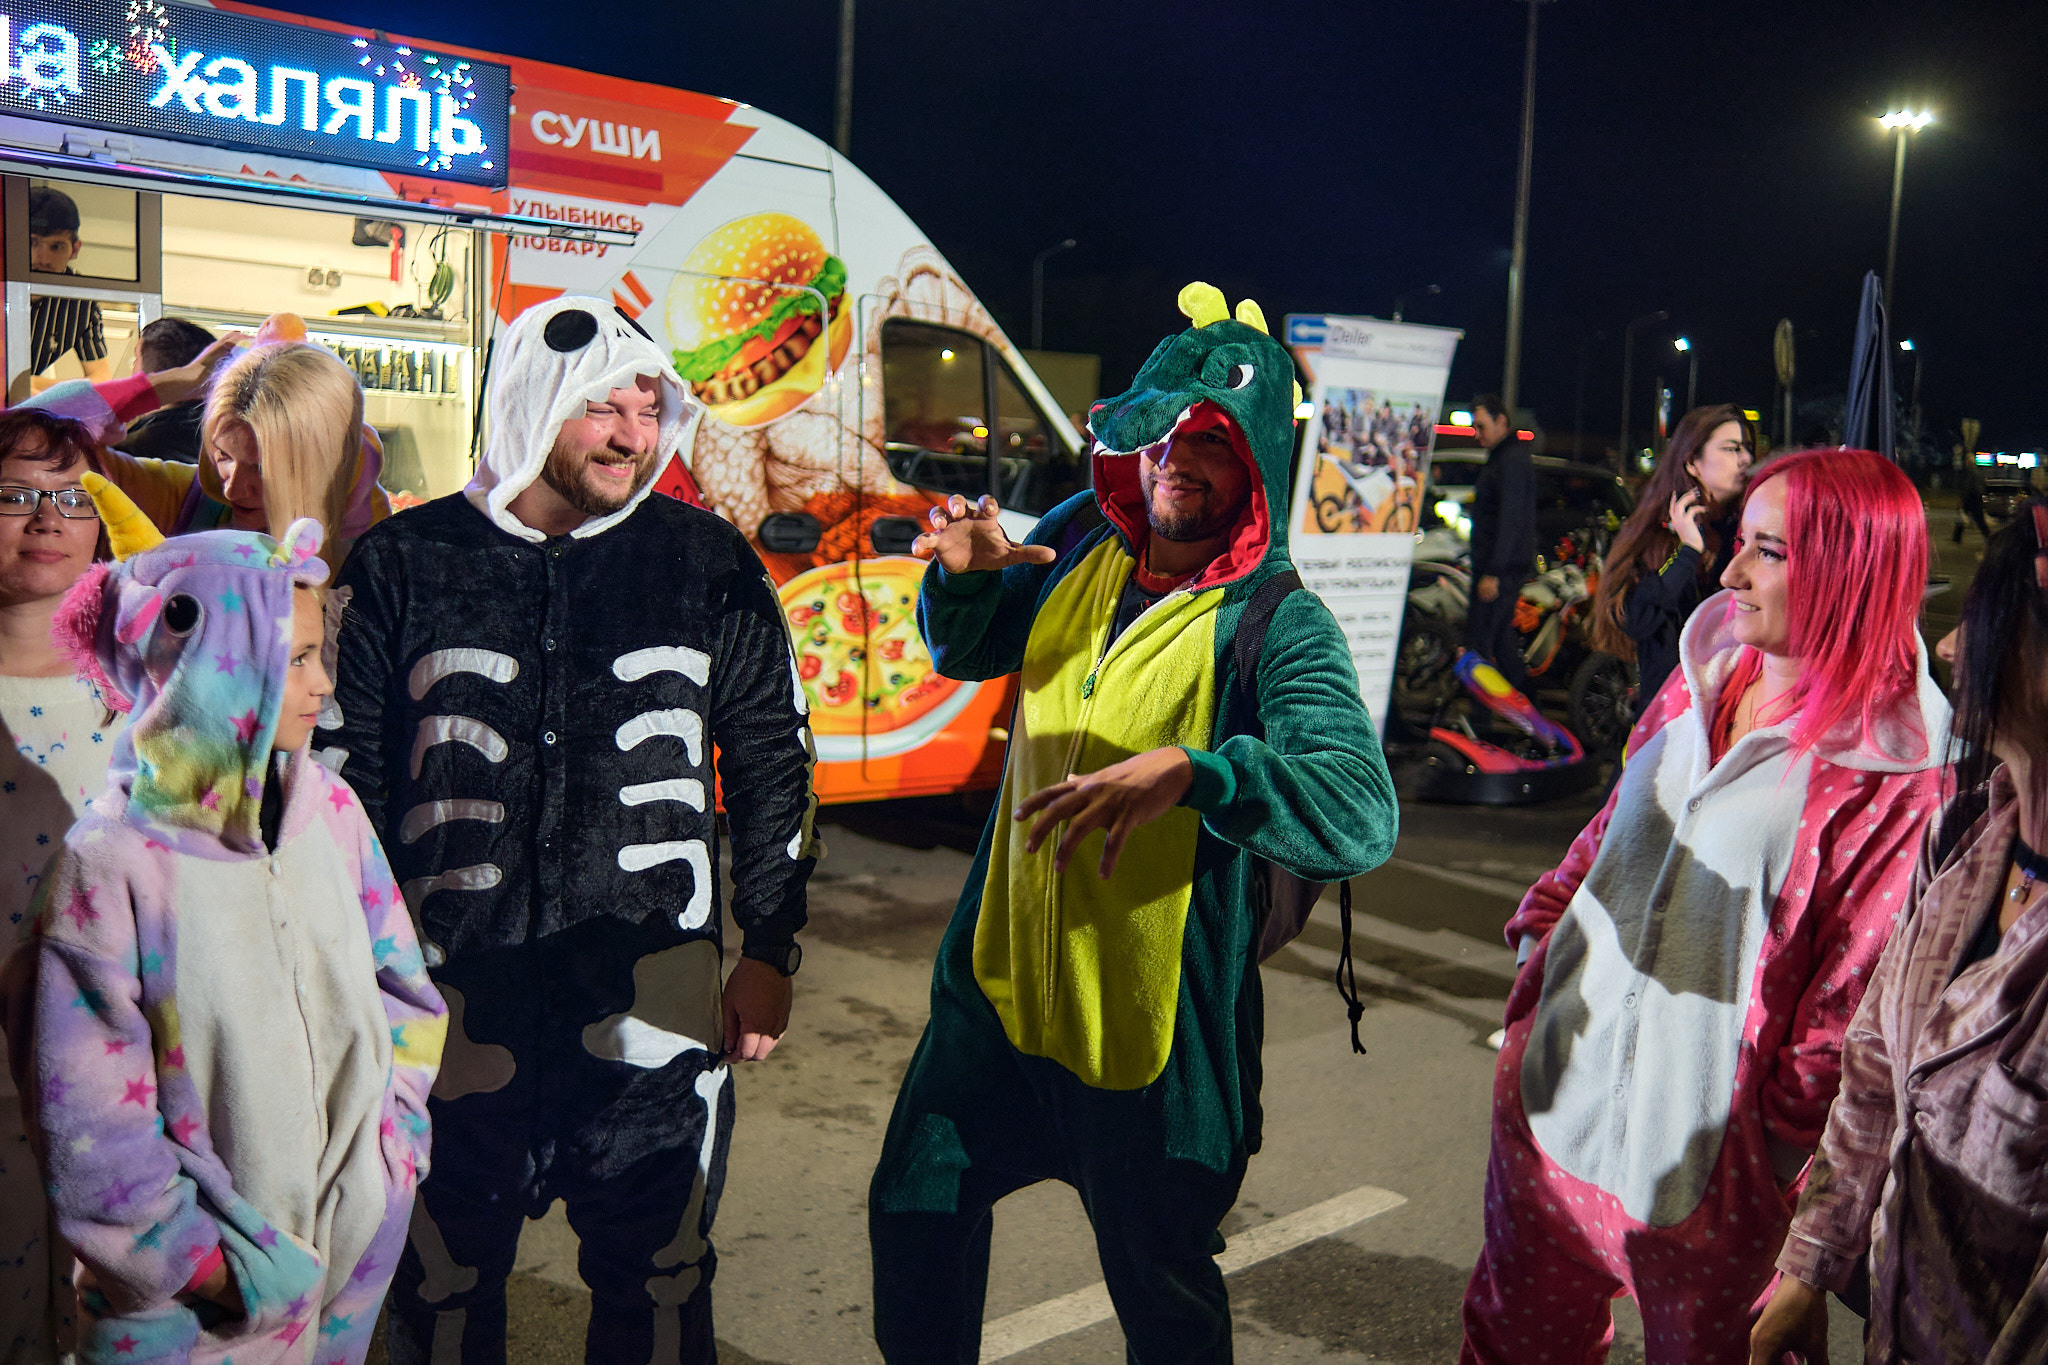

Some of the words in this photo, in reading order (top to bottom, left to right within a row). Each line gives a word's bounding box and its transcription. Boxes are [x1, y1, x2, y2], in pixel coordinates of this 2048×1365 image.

[150, 42, 485, 156] халяль
[530, 109, 662, 162] СУШИ
[513, 198, 644, 231] УЛЫБНИСЬ
[513, 234, 610, 258] ПОВАРУ
